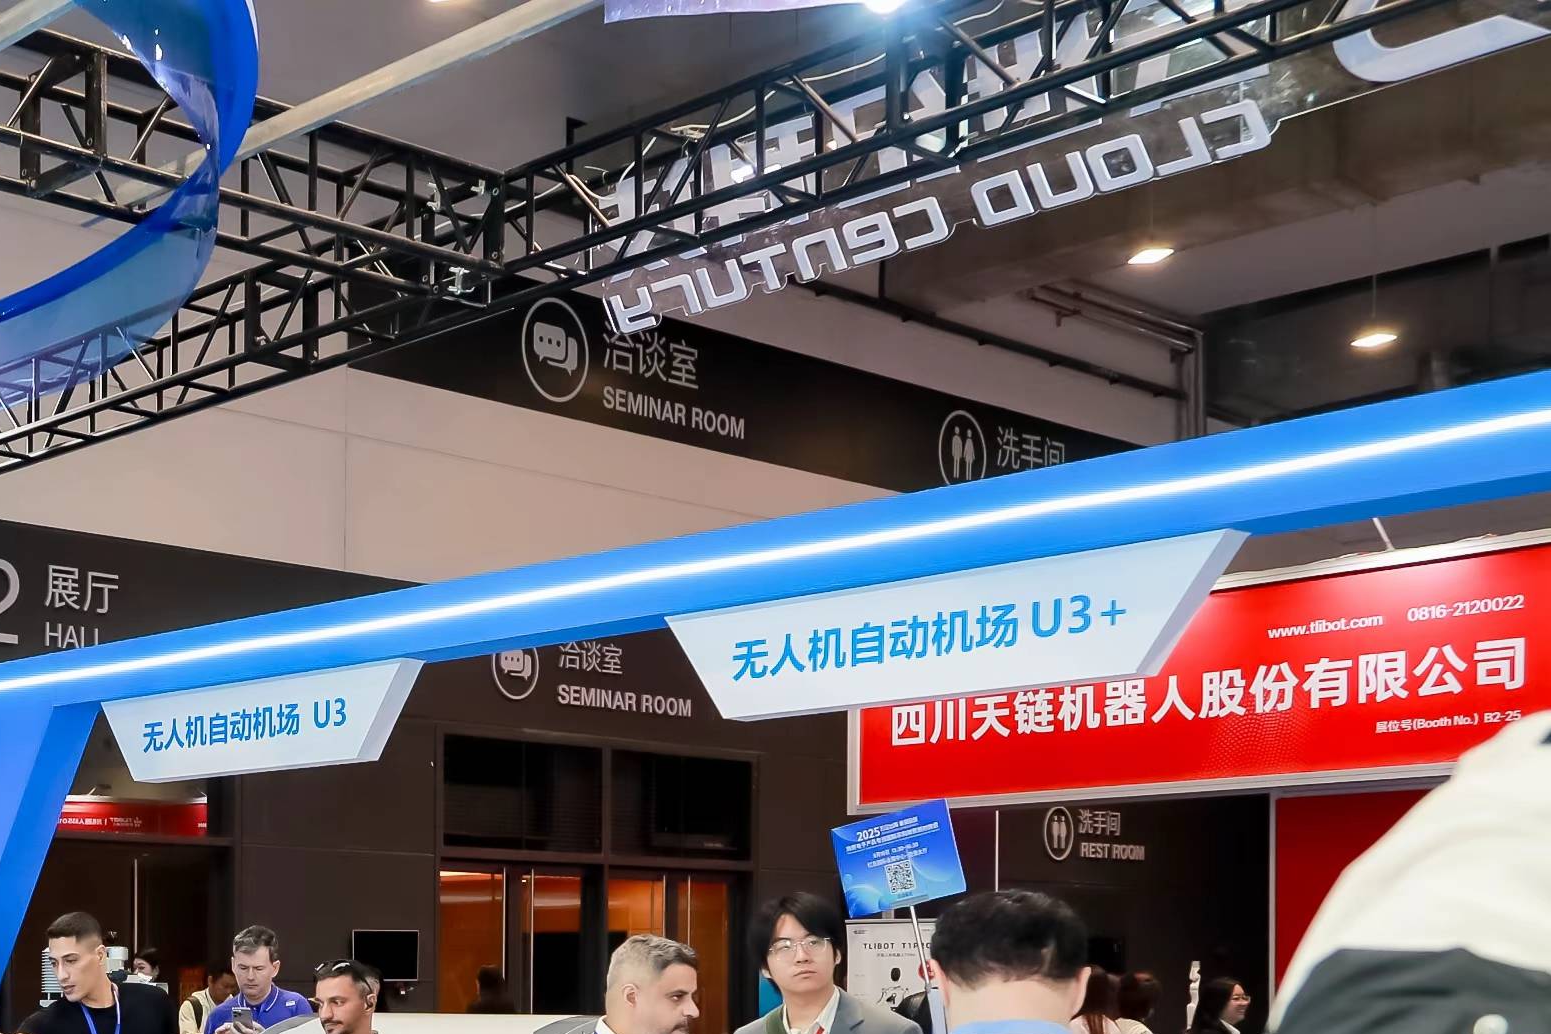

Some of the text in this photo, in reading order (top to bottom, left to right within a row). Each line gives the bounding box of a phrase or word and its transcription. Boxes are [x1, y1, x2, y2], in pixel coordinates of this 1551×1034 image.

[602, 326, 700, 390] 洽谈室
[602, 385, 746, 440] SEMINAR ROOM
[996, 424, 1065, 472] 洗手间
[45, 564, 120, 614] 展厅
[731, 594, 1127, 683] 无人机自动机场 U3+
[1267, 593, 1526, 640] www.tlibot.com 0816-2120022
[558, 641, 624, 676] 洽谈室
[557, 684, 693, 718] SEMINAR ROOM
[890, 636, 1527, 748] 四川天链机器人股份有限公司
[142, 697, 348, 754] 无人机自动机场 U3
[1483, 709, 1523, 724] B2-25
[856, 827, 881, 842] 2025
[1078, 808, 1121, 836] 洗手间
[1080, 841, 1146, 861] REST ROOM
[863, 942, 895, 950] TLIBOT
